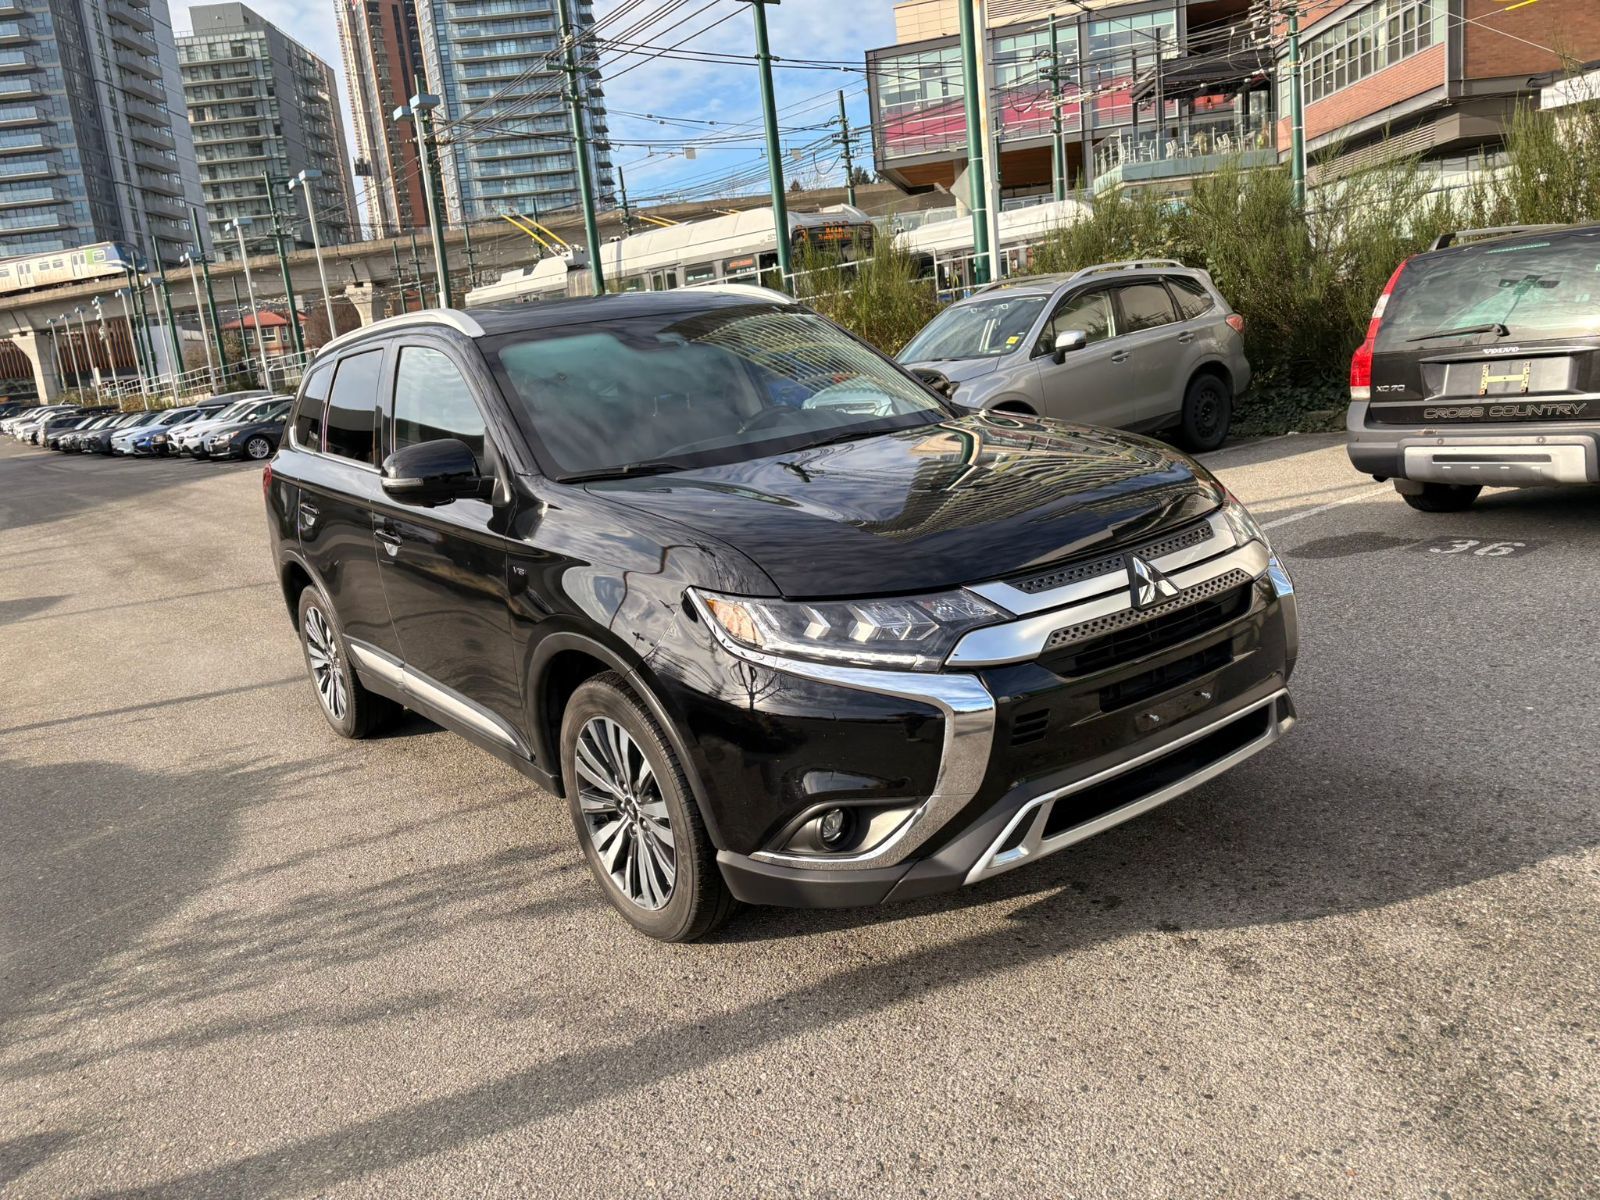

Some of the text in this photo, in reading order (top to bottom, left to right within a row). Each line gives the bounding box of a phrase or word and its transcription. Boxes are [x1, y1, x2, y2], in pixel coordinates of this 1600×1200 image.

[1424, 403, 1587, 419] CROSS COUNTRY
[1429, 540, 1526, 556] 36
